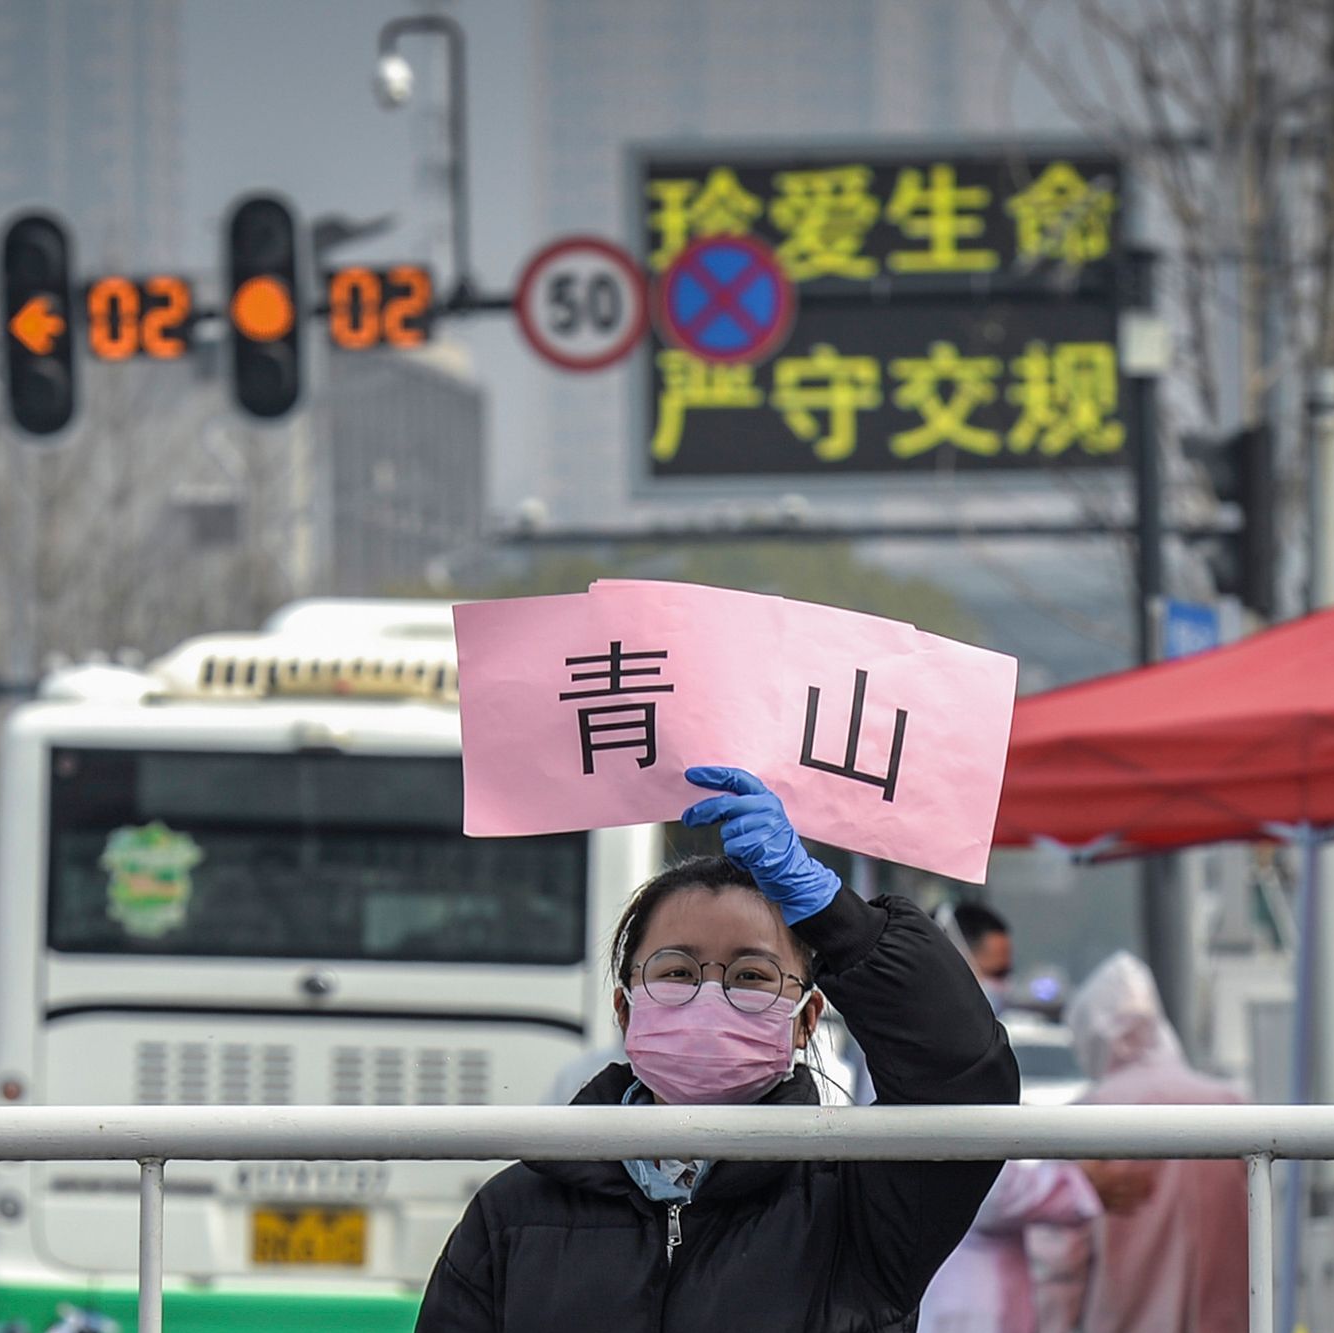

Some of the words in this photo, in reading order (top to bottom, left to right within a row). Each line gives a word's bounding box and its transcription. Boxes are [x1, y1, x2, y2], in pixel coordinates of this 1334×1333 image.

[87, 277, 190, 360] 02
[329, 266, 431, 348] 02
[549, 273, 620, 334] 50
[559, 641, 907, 802] 青山
